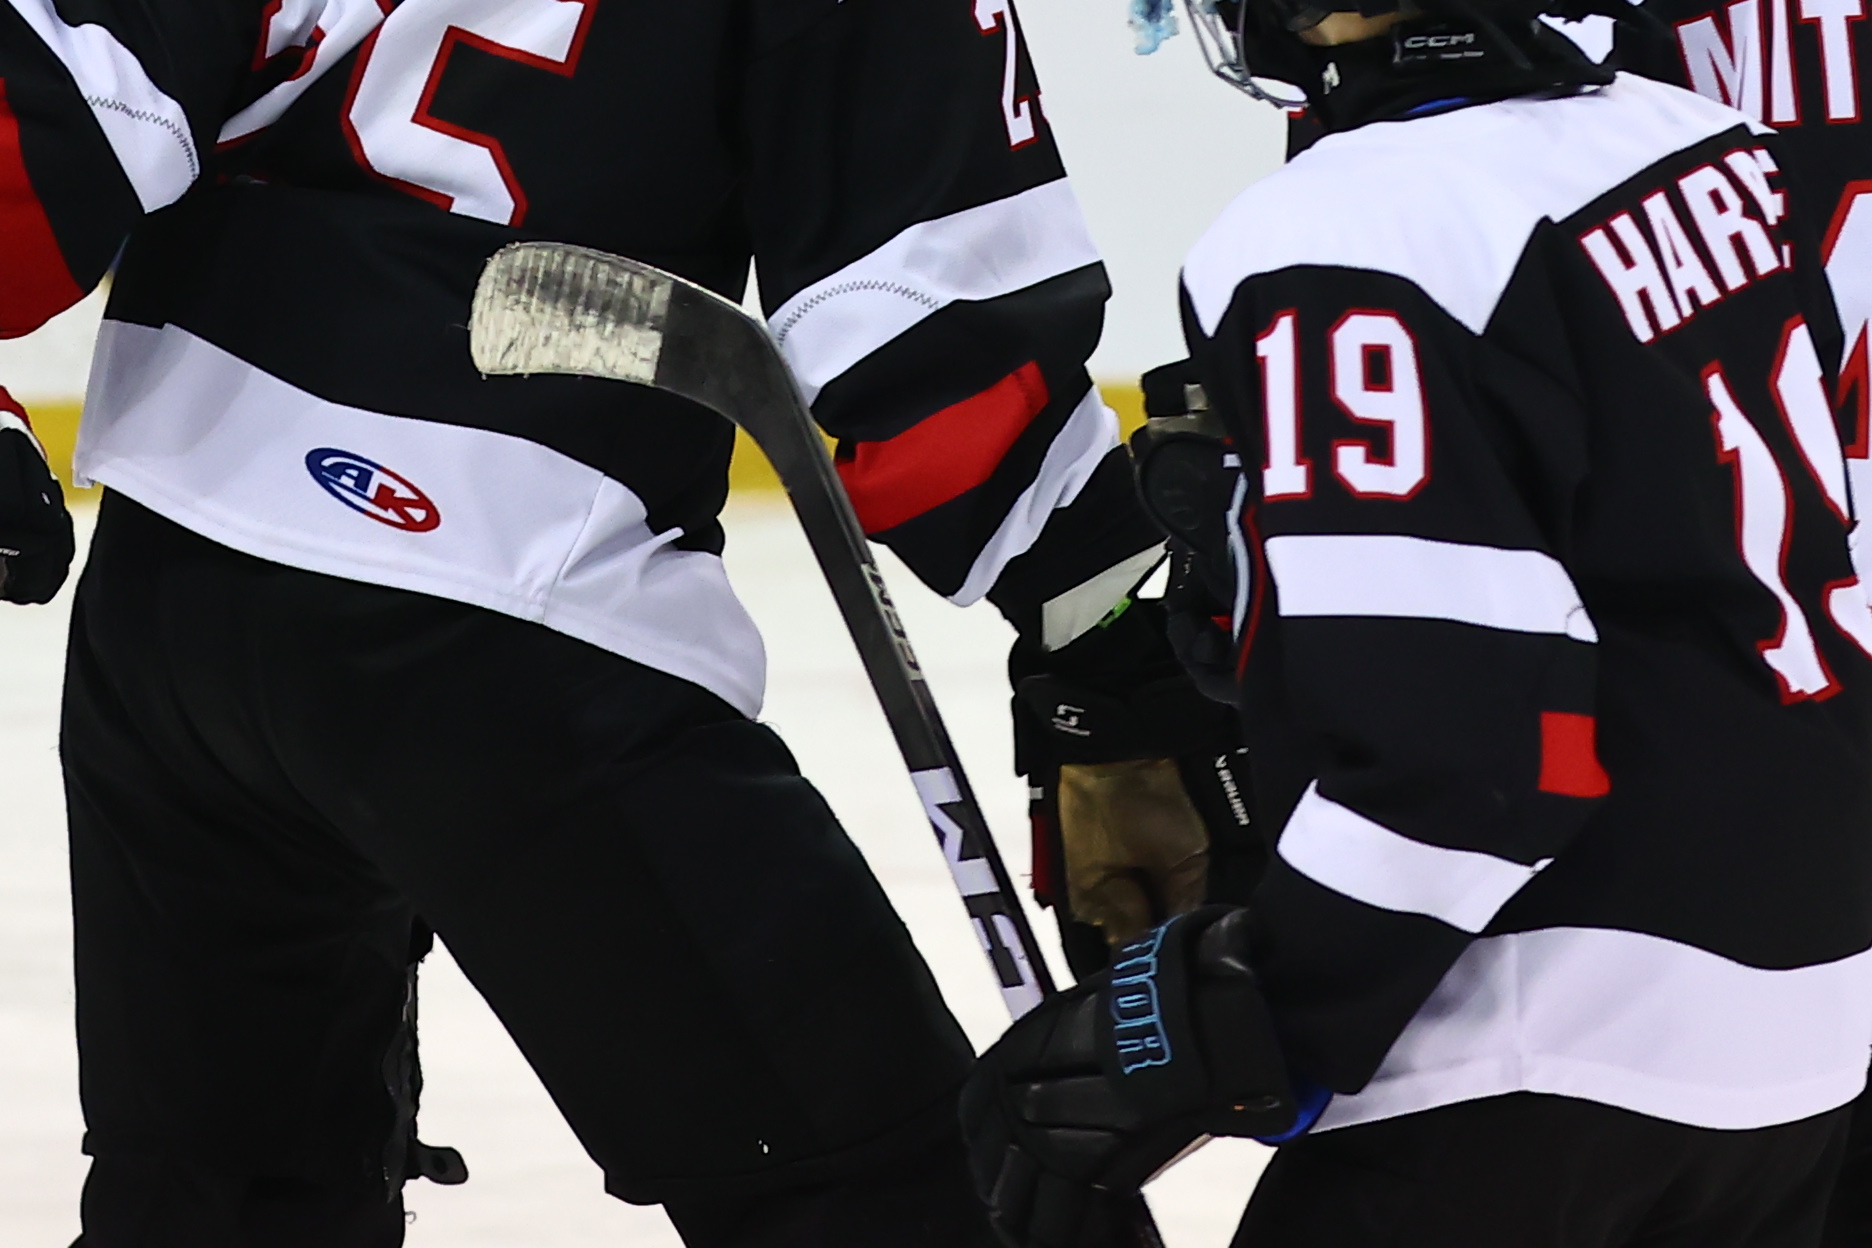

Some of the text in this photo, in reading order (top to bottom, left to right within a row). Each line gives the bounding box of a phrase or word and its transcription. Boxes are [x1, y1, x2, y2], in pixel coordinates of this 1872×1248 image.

[1404, 33, 1475, 49] CCM
[1255, 307, 1430, 502] 19
[910, 766, 1045, 1022] CM
